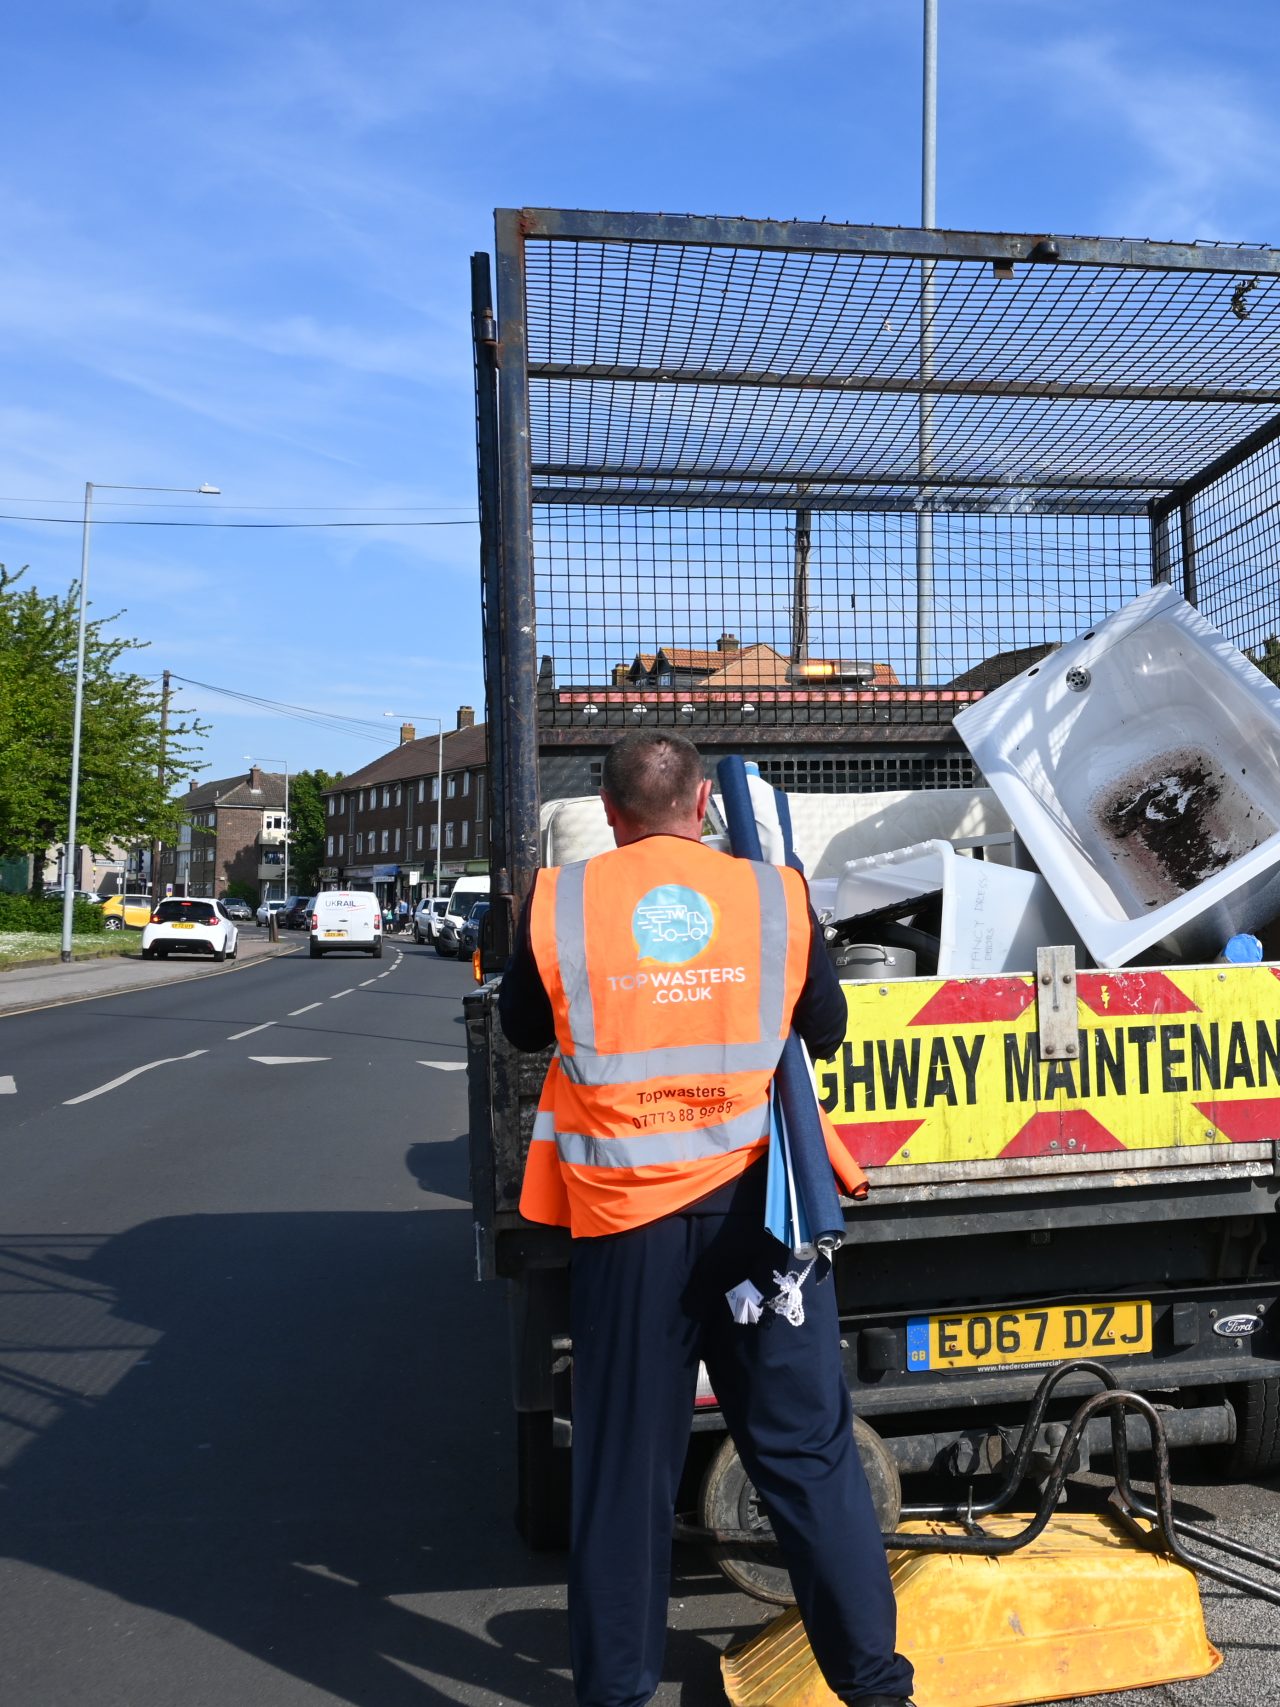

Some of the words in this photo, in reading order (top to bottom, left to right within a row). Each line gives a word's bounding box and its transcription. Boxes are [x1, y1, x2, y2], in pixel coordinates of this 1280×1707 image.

[607, 966, 746, 992] TOPWASTERS
[652, 986, 712, 1004] .CO.UK
[814, 1034, 986, 1114] GHWAY
[636, 1086, 726, 1105] Topwasters
[678, 1108, 694, 1122] 88
[938, 1312, 1049, 1359] EO67
[1063, 1304, 1144, 1349] DZJ
[1225, 1319, 1253, 1333] Ford
[911, 1350, 926, 1361] GB
